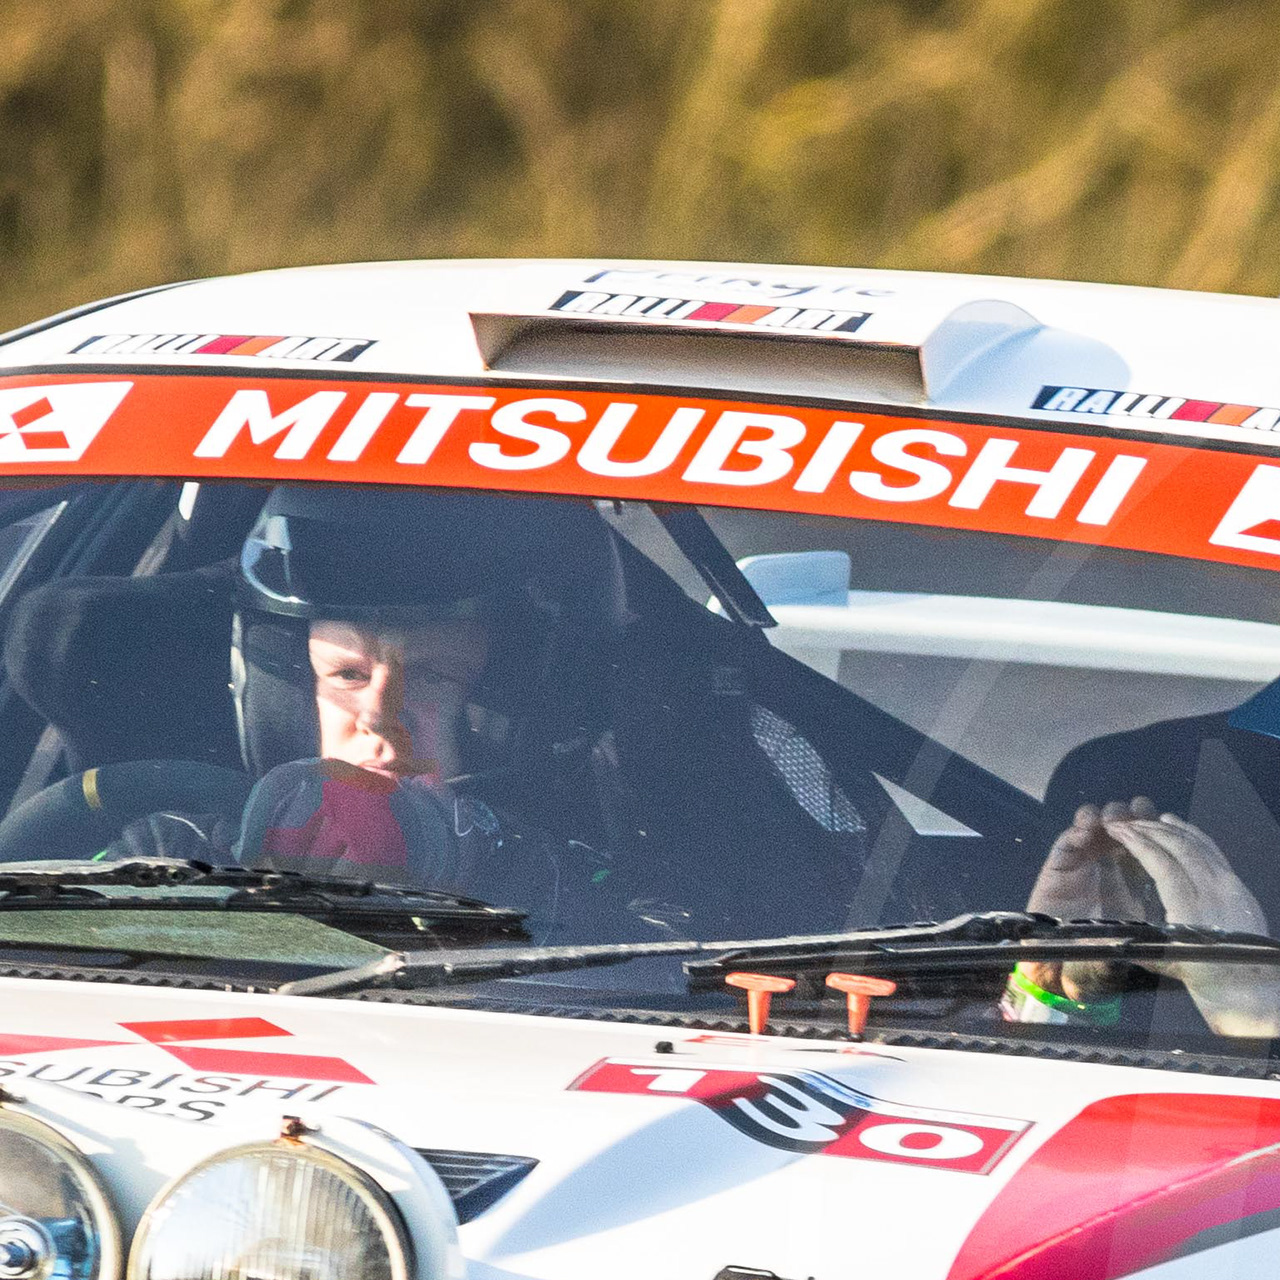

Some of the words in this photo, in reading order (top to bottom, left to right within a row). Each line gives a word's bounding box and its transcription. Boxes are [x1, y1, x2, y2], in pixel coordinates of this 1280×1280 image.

[1043, 387, 1188, 420] RALLI
[192, 389, 1149, 527] MITSUBISHI
[630, 1065, 985, 1161] 130
